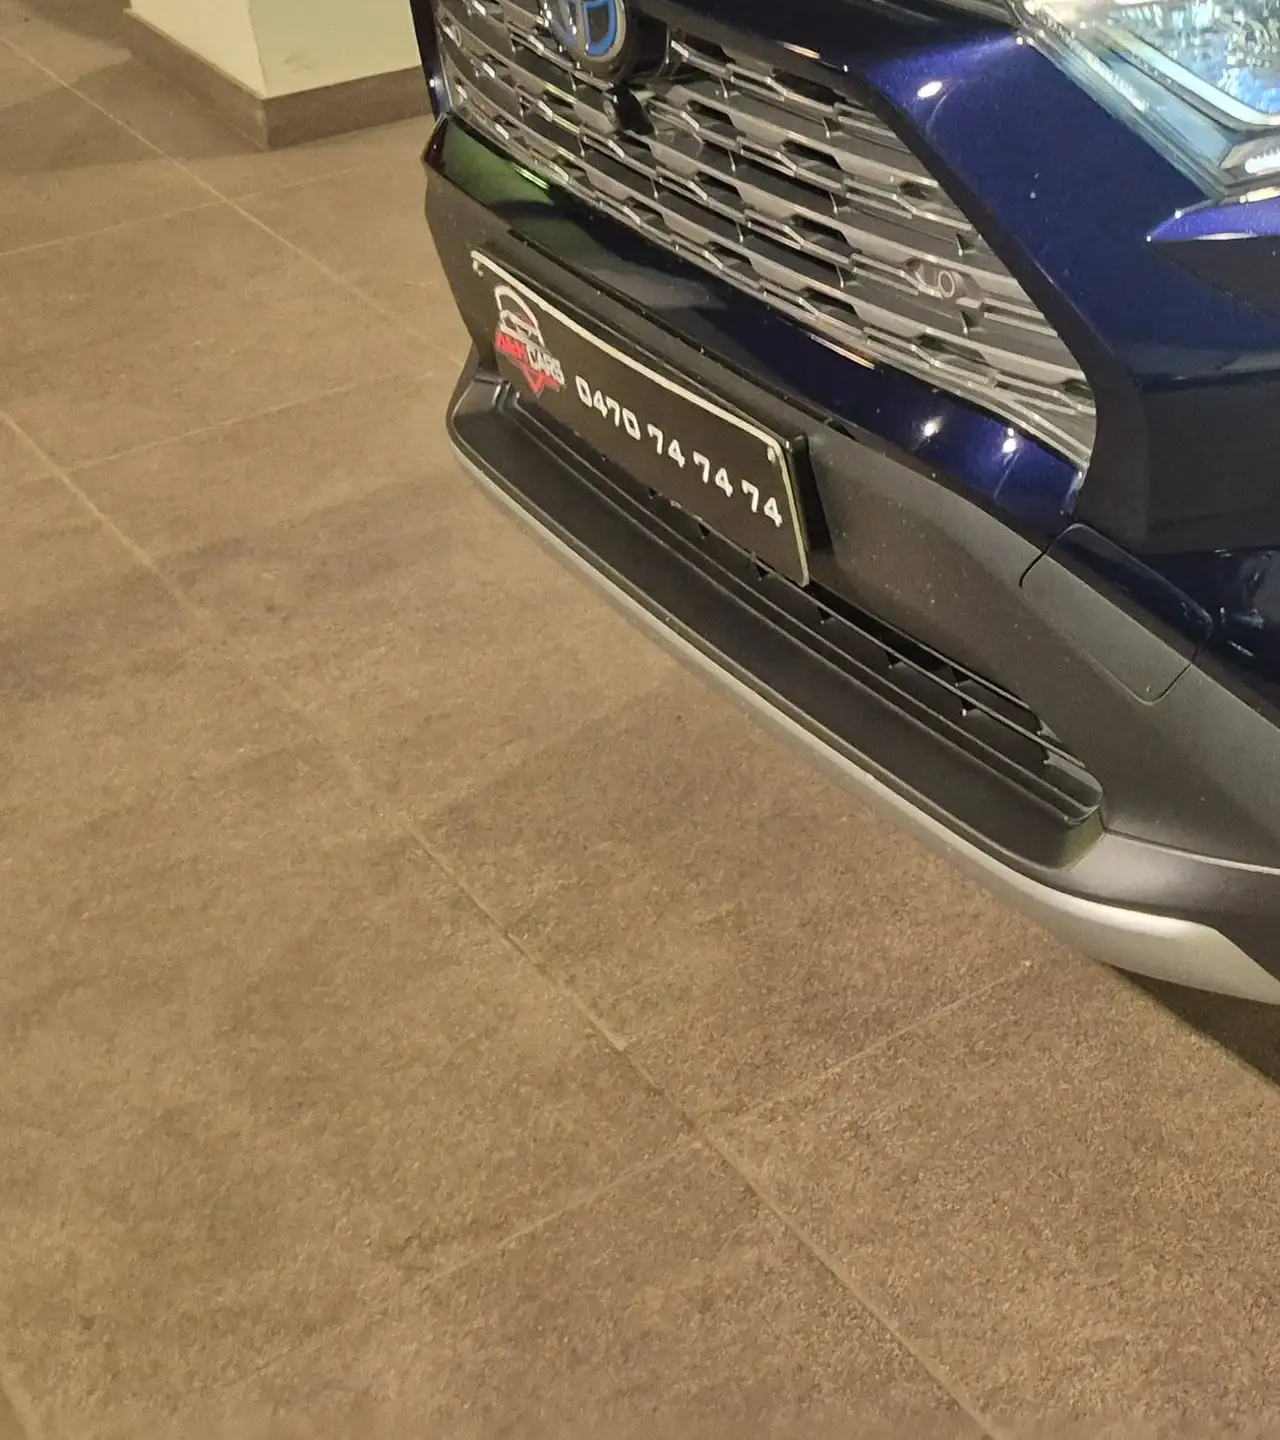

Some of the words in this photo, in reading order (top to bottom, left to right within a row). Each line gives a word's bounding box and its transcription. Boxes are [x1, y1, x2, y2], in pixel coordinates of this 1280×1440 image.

[575, 374, 641, 441] 0470
[647, 423, 686, 468] 74
[693, 451, 733, 498] 74
[741, 479, 782, 528] 74
